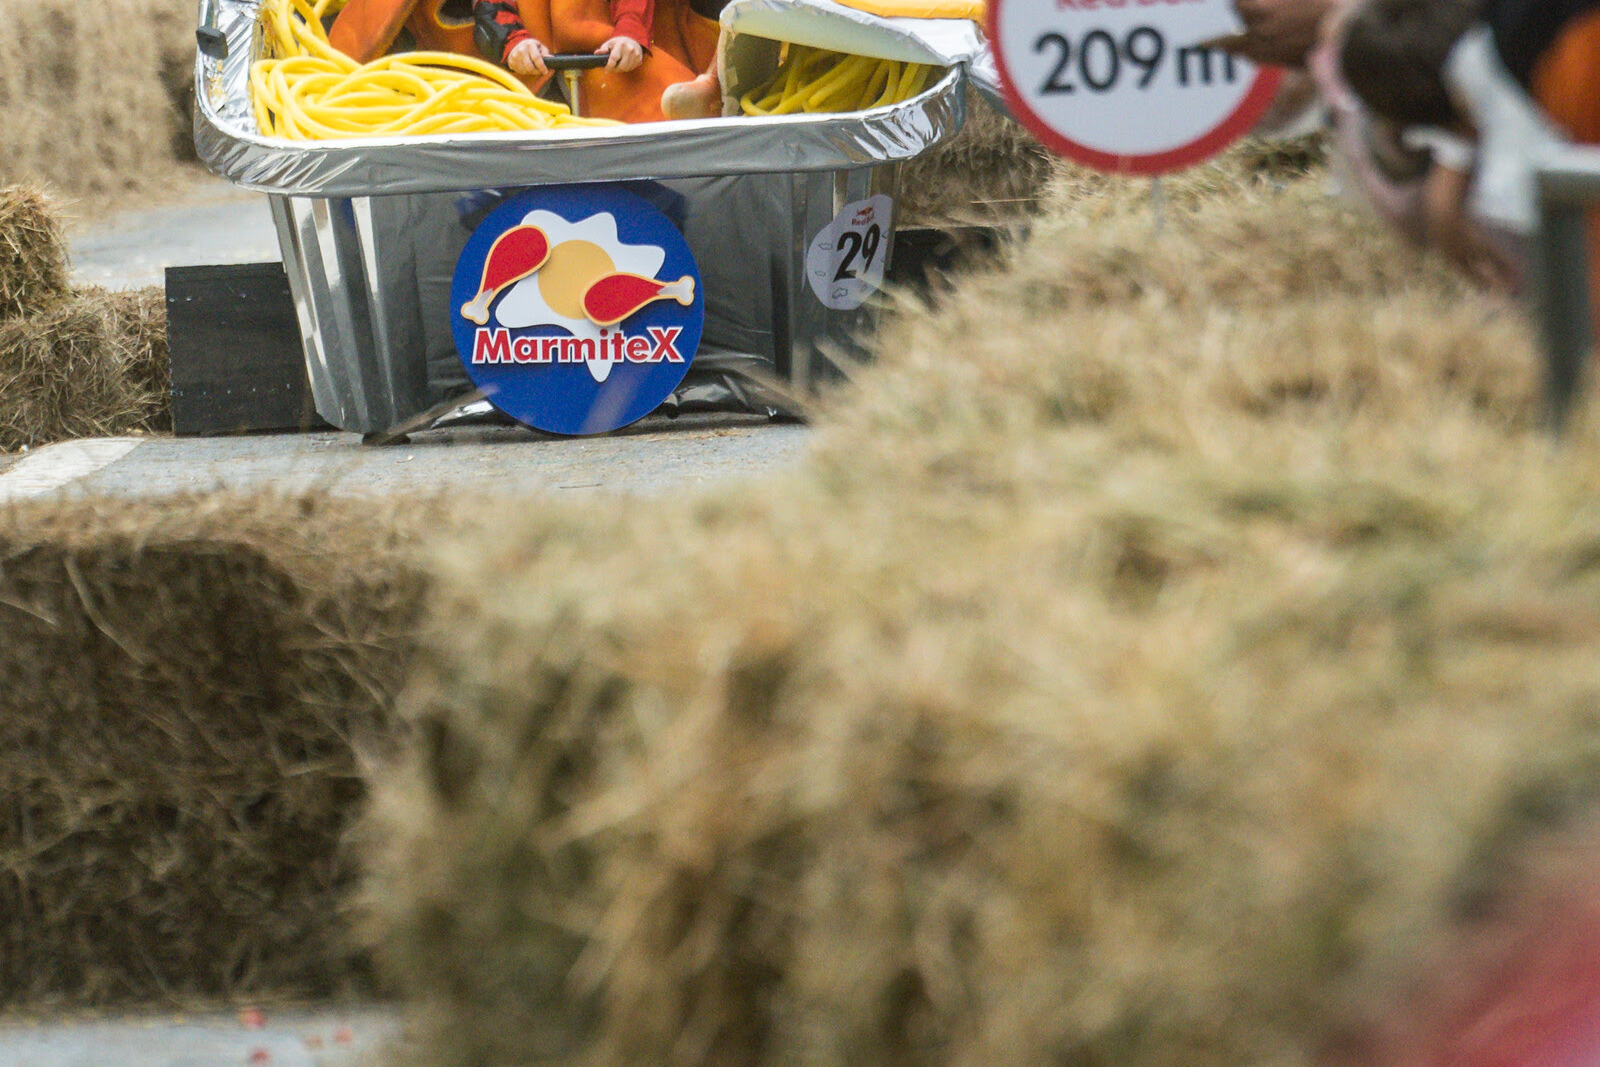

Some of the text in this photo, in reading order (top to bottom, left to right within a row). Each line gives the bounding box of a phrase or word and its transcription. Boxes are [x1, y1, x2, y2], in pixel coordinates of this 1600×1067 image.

[1032, 26, 1237, 96] 209m
[833, 223, 880, 283] 29
[472, 327, 685, 364] MarmiteX
